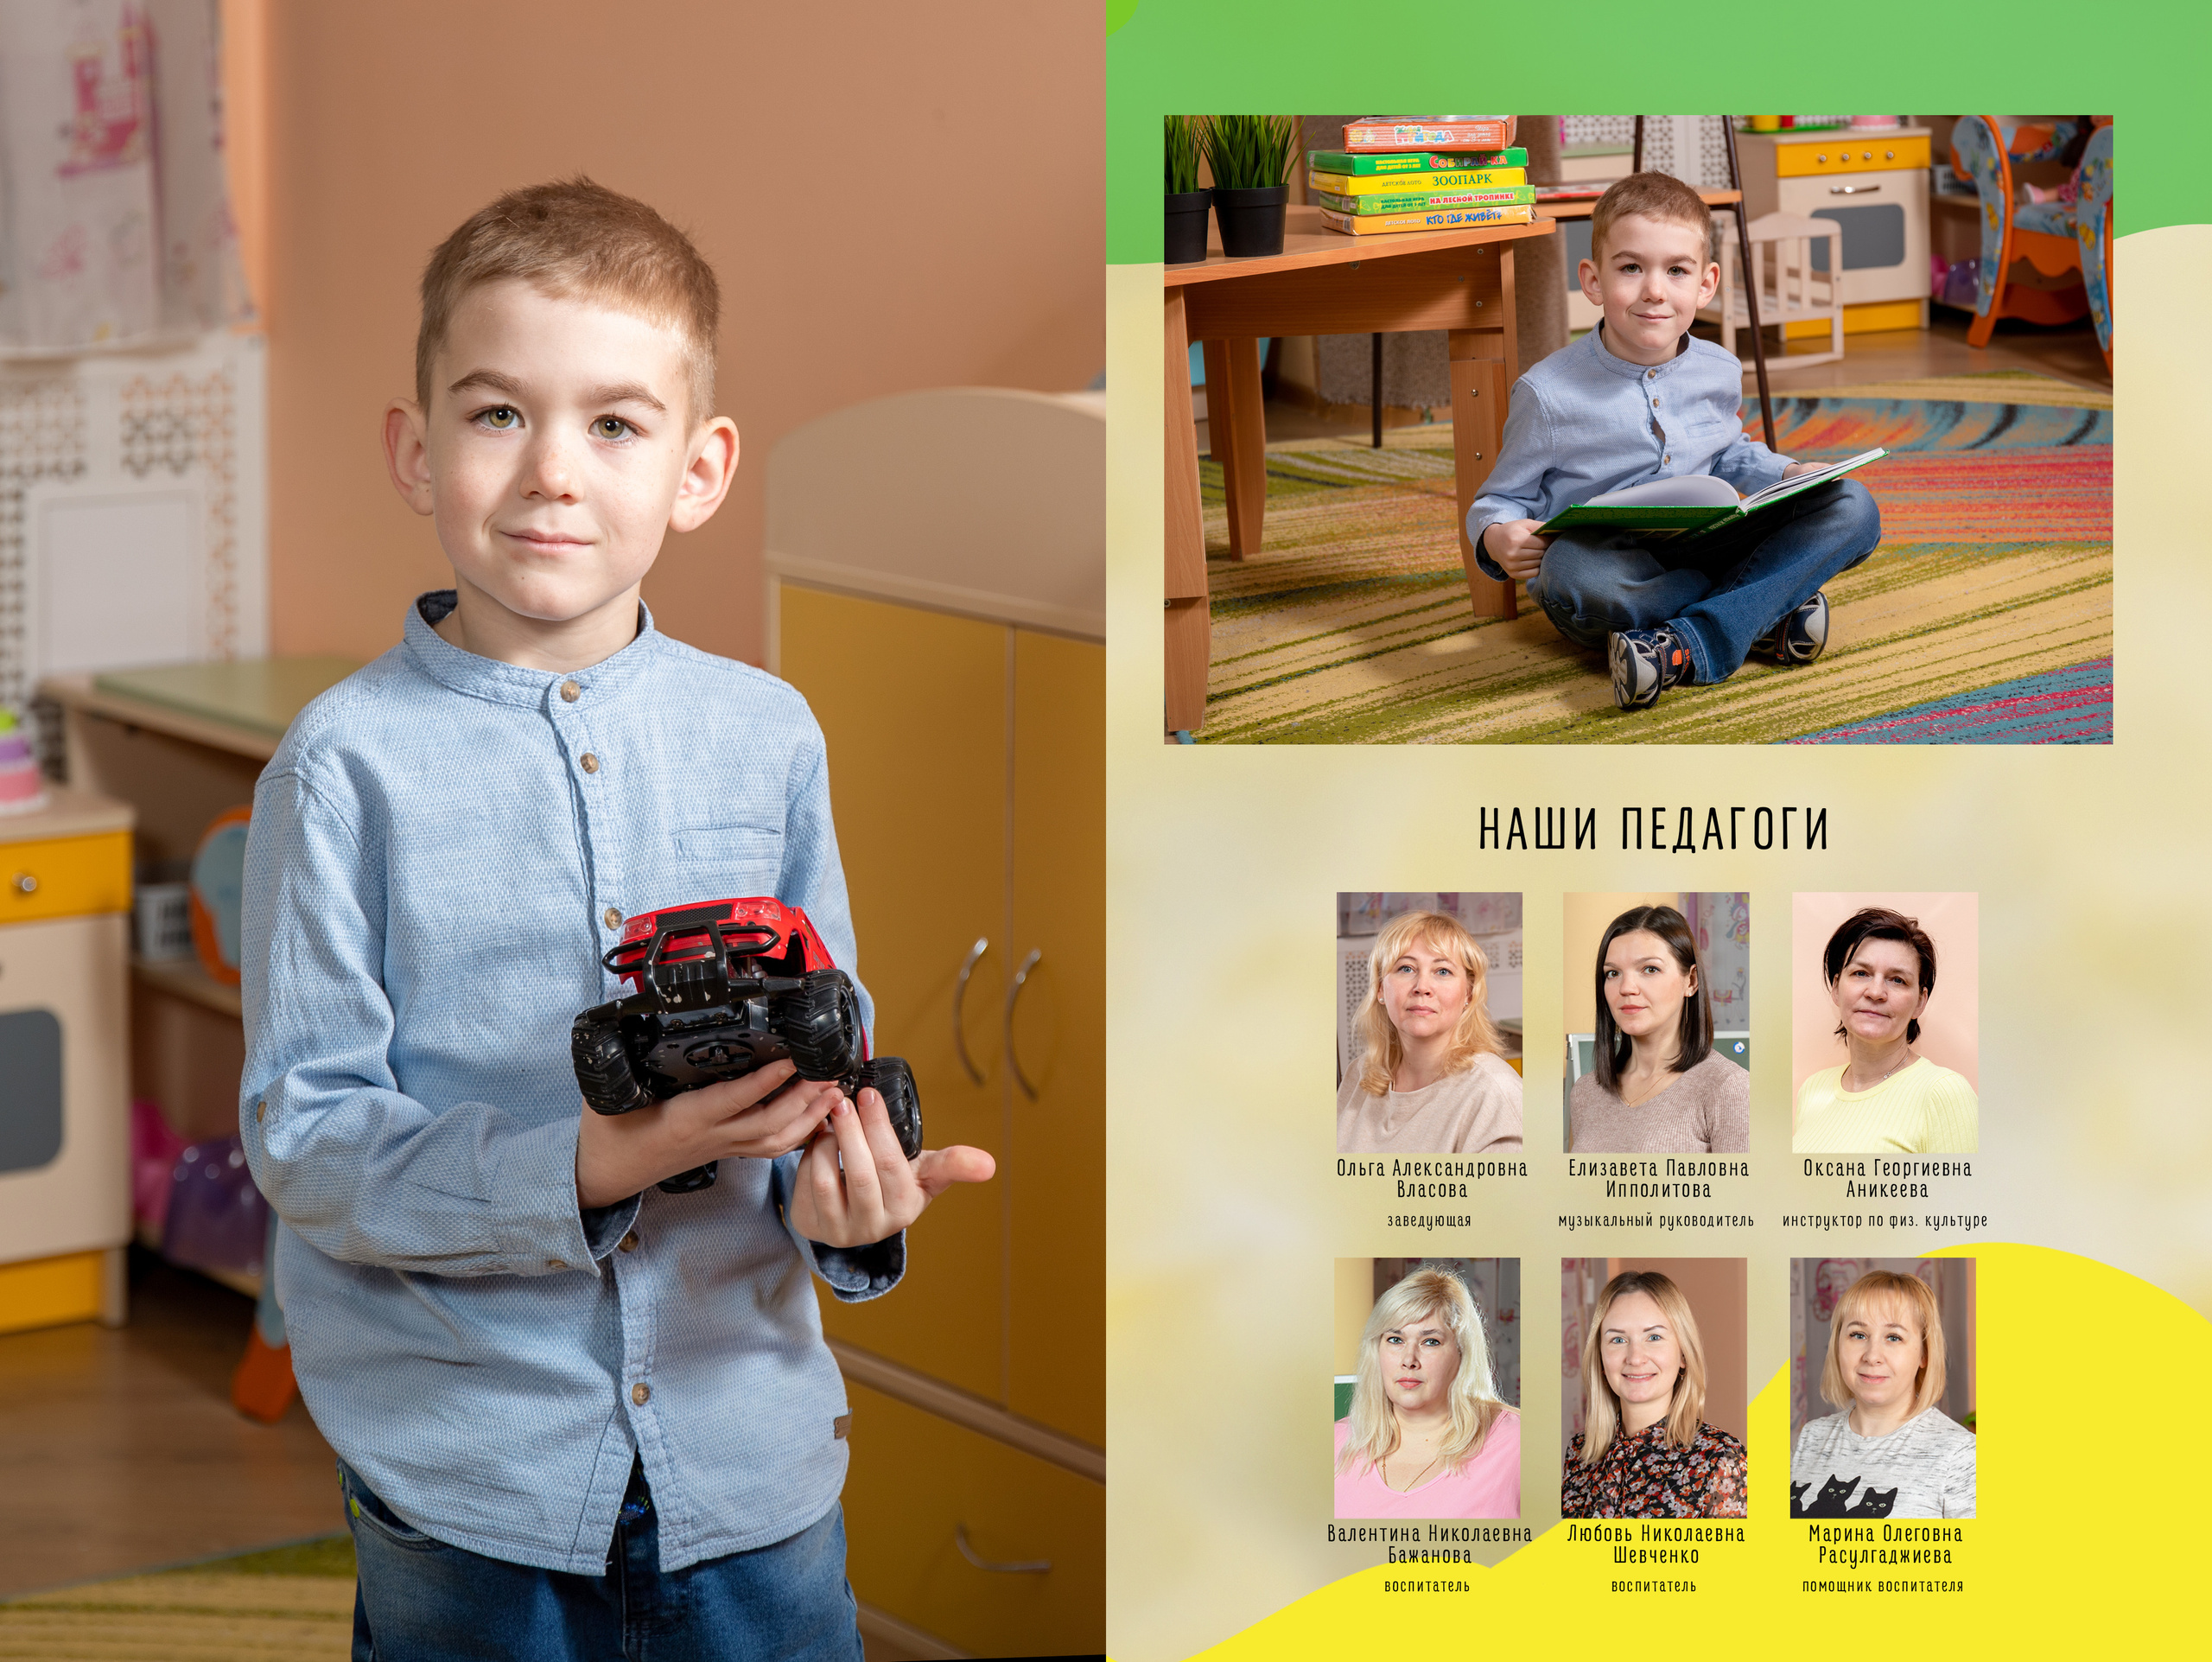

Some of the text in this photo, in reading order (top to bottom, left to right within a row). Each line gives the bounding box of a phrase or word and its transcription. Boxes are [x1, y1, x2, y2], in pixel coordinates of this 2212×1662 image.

[1396, 131, 1453, 143] ПРИРОДА
[1433, 174, 1492, 186] ЗООПАРК
[1442, 194, 1473, 204] ЛЕСНОЙ
[1474, 192, 1515, 202] ТРОПИНКЕ
[1426, 213, 1444, 225] КТО
[1446, 213, 1464, 224] ГДЕ
